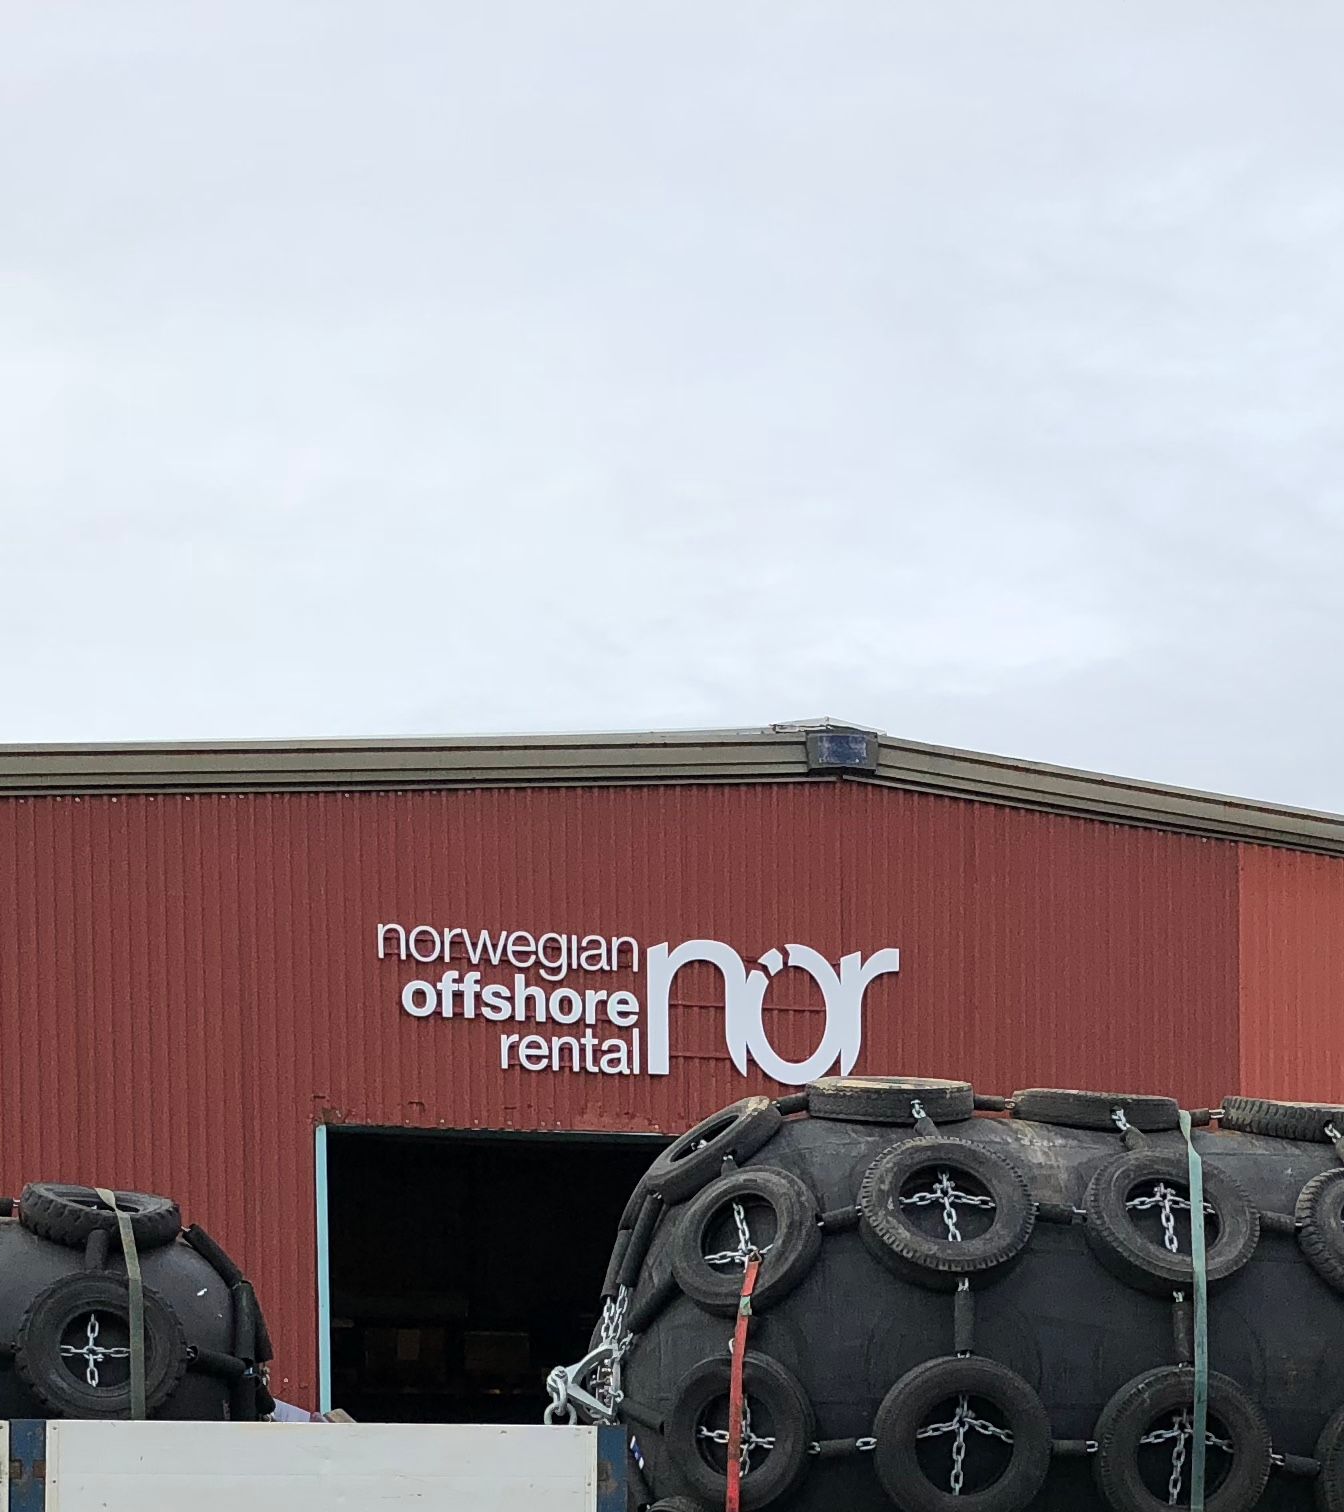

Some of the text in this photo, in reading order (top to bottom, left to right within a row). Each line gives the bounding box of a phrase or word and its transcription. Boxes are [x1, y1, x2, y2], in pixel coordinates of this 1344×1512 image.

[377, 922, 639, 981] norwegian
[401, 970, 640, 1027] offshore
[500, 1027, 640, 1075] rental
